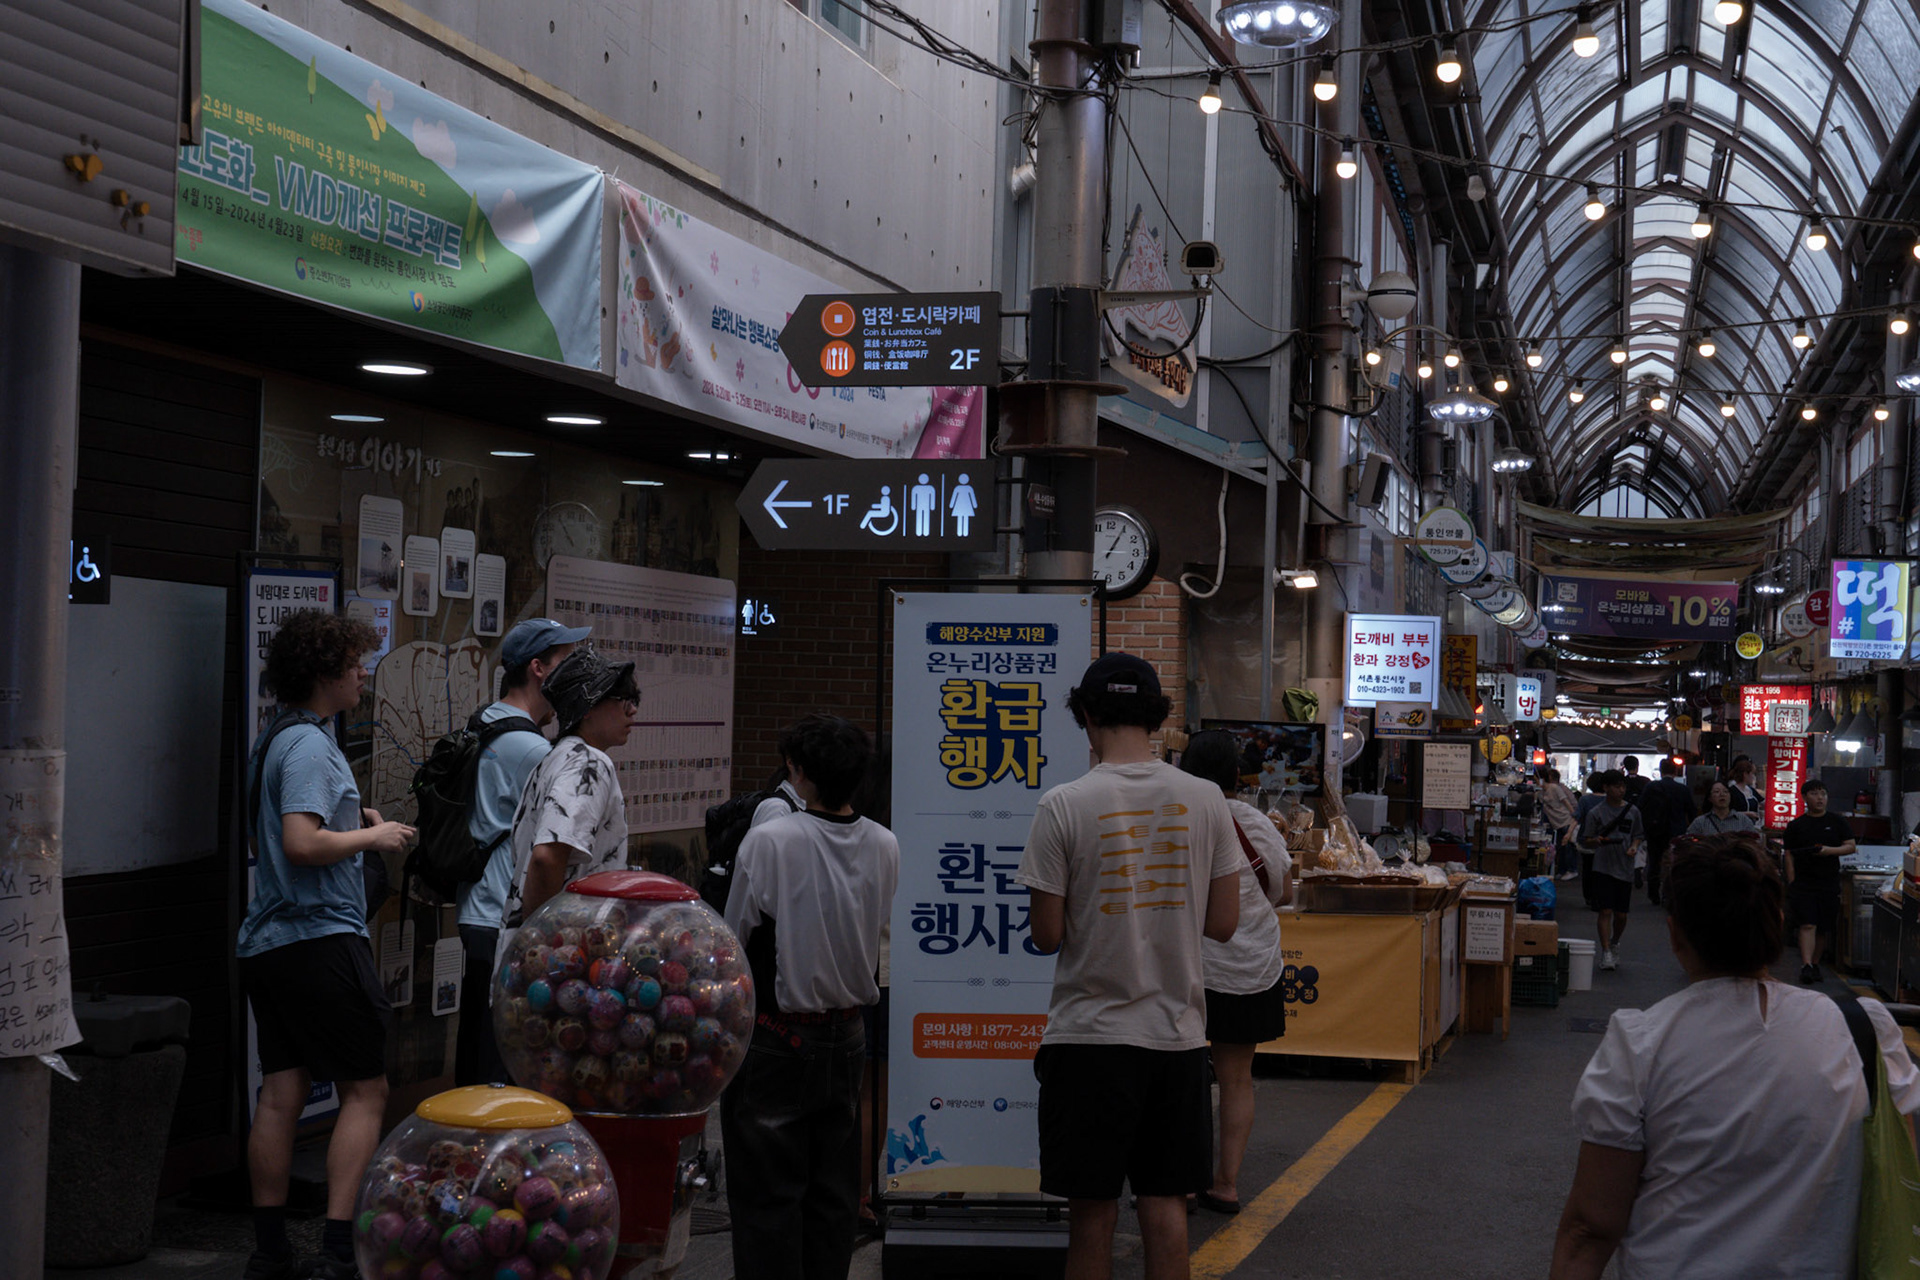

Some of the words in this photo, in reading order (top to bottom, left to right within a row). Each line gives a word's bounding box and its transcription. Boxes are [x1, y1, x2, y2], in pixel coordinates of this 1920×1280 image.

[274, 155, 382, 243] VMD개선
[383, 198, 463, 270] 프로젝트
[712, 305, 747, 340] 살맛나는
[863, 327, 879, 336] Coin
[881, 328, 886, 336] &
[888, 327, 922, 336] Lunchbox
[924, 327, 942, 336] Café
[949, 348, 981, 371] 2F
[361, 436, 422, 485] 이야기
[822, 494, 850, 515] 1F
[293, 586, 317, 602] 도시락
[1615, 589, 1650, 602] 모바일
[1836, 563, 1905, 639] 떡
[1597, 601, 1666, 616] 온누리상품권
[1667, 595, 1731, 627] 10%
[1708, 616, 1730, 627] 할인
[939, 626, 1013, 642] 해양수산부
[1016, 626, 1045, 643] 지원
[1353, 632, 1394, 646] 도깨비
[1402, 633, 1430, 647] 부부
[926, 652, 1057, 674] 온누리상품권
[1353, 653, 1378, 667] 한과
[1385, 654, 1410, 668] 강정
[1854, 650, 1892, 659] 720-6225
[1743, 686, 1764, 695] SINCE
[939, 678, 1047, 732] 환급
[1519, 696, 1537, 717] 밥
[1744, 695, 1762, 711] 최초
[1744, 712, 1762, 732] 원조
[939, 735, 1048, 790] 행사
[1773, 749, 1801, 759] 할머니
[937, 842, 1031, 895] 환급
[922, 1023, 946, 1036] 문의
[948, 1023, 972, 1036] 사항
[946, 1099, 985, 1109] 해양수산부
